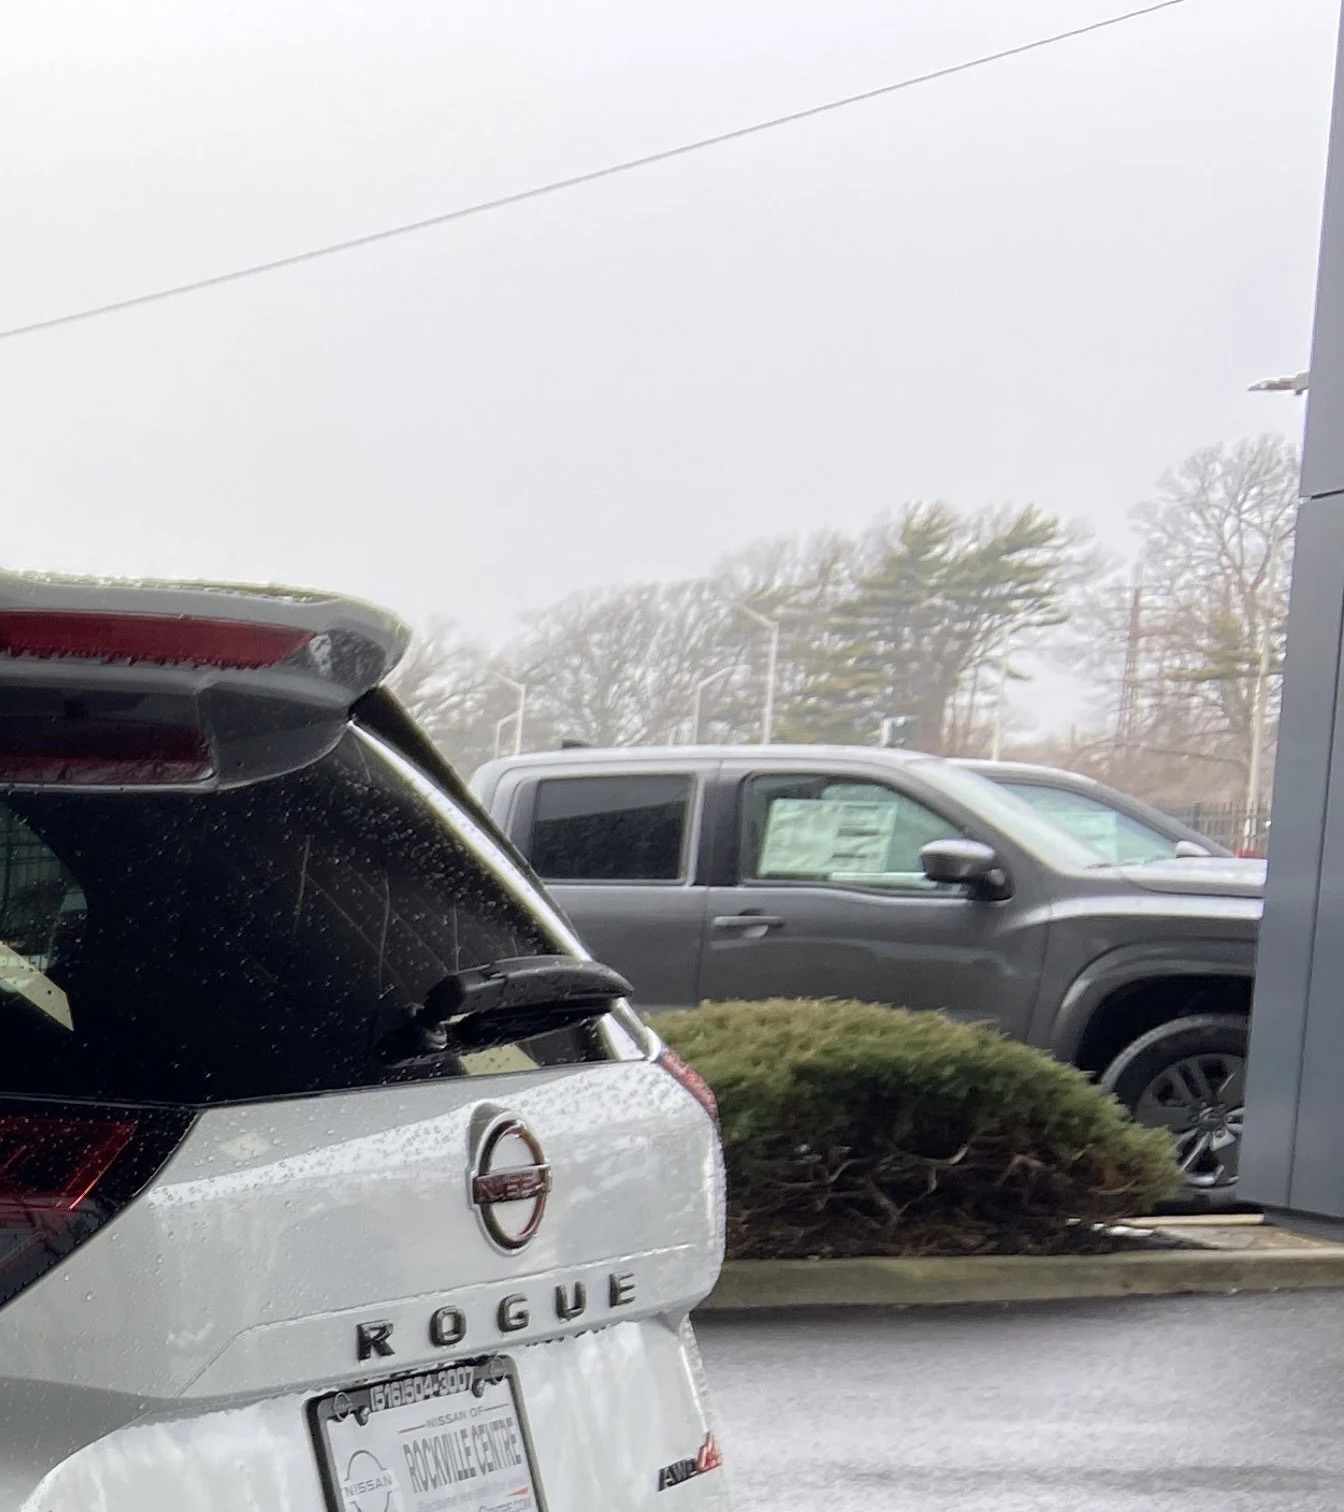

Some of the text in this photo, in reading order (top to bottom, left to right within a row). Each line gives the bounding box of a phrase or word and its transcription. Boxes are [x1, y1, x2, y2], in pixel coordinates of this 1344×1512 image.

[357, 1271, 636, 1361] ROGUE
[427, 1405, 485, 1428] NISSAN OF
[403, 1429, 476, 1494] ROCKVILLE
[472, 1416, 522, 1476] CENTRE
[344, 1475, 393, 1497] NISSAN
